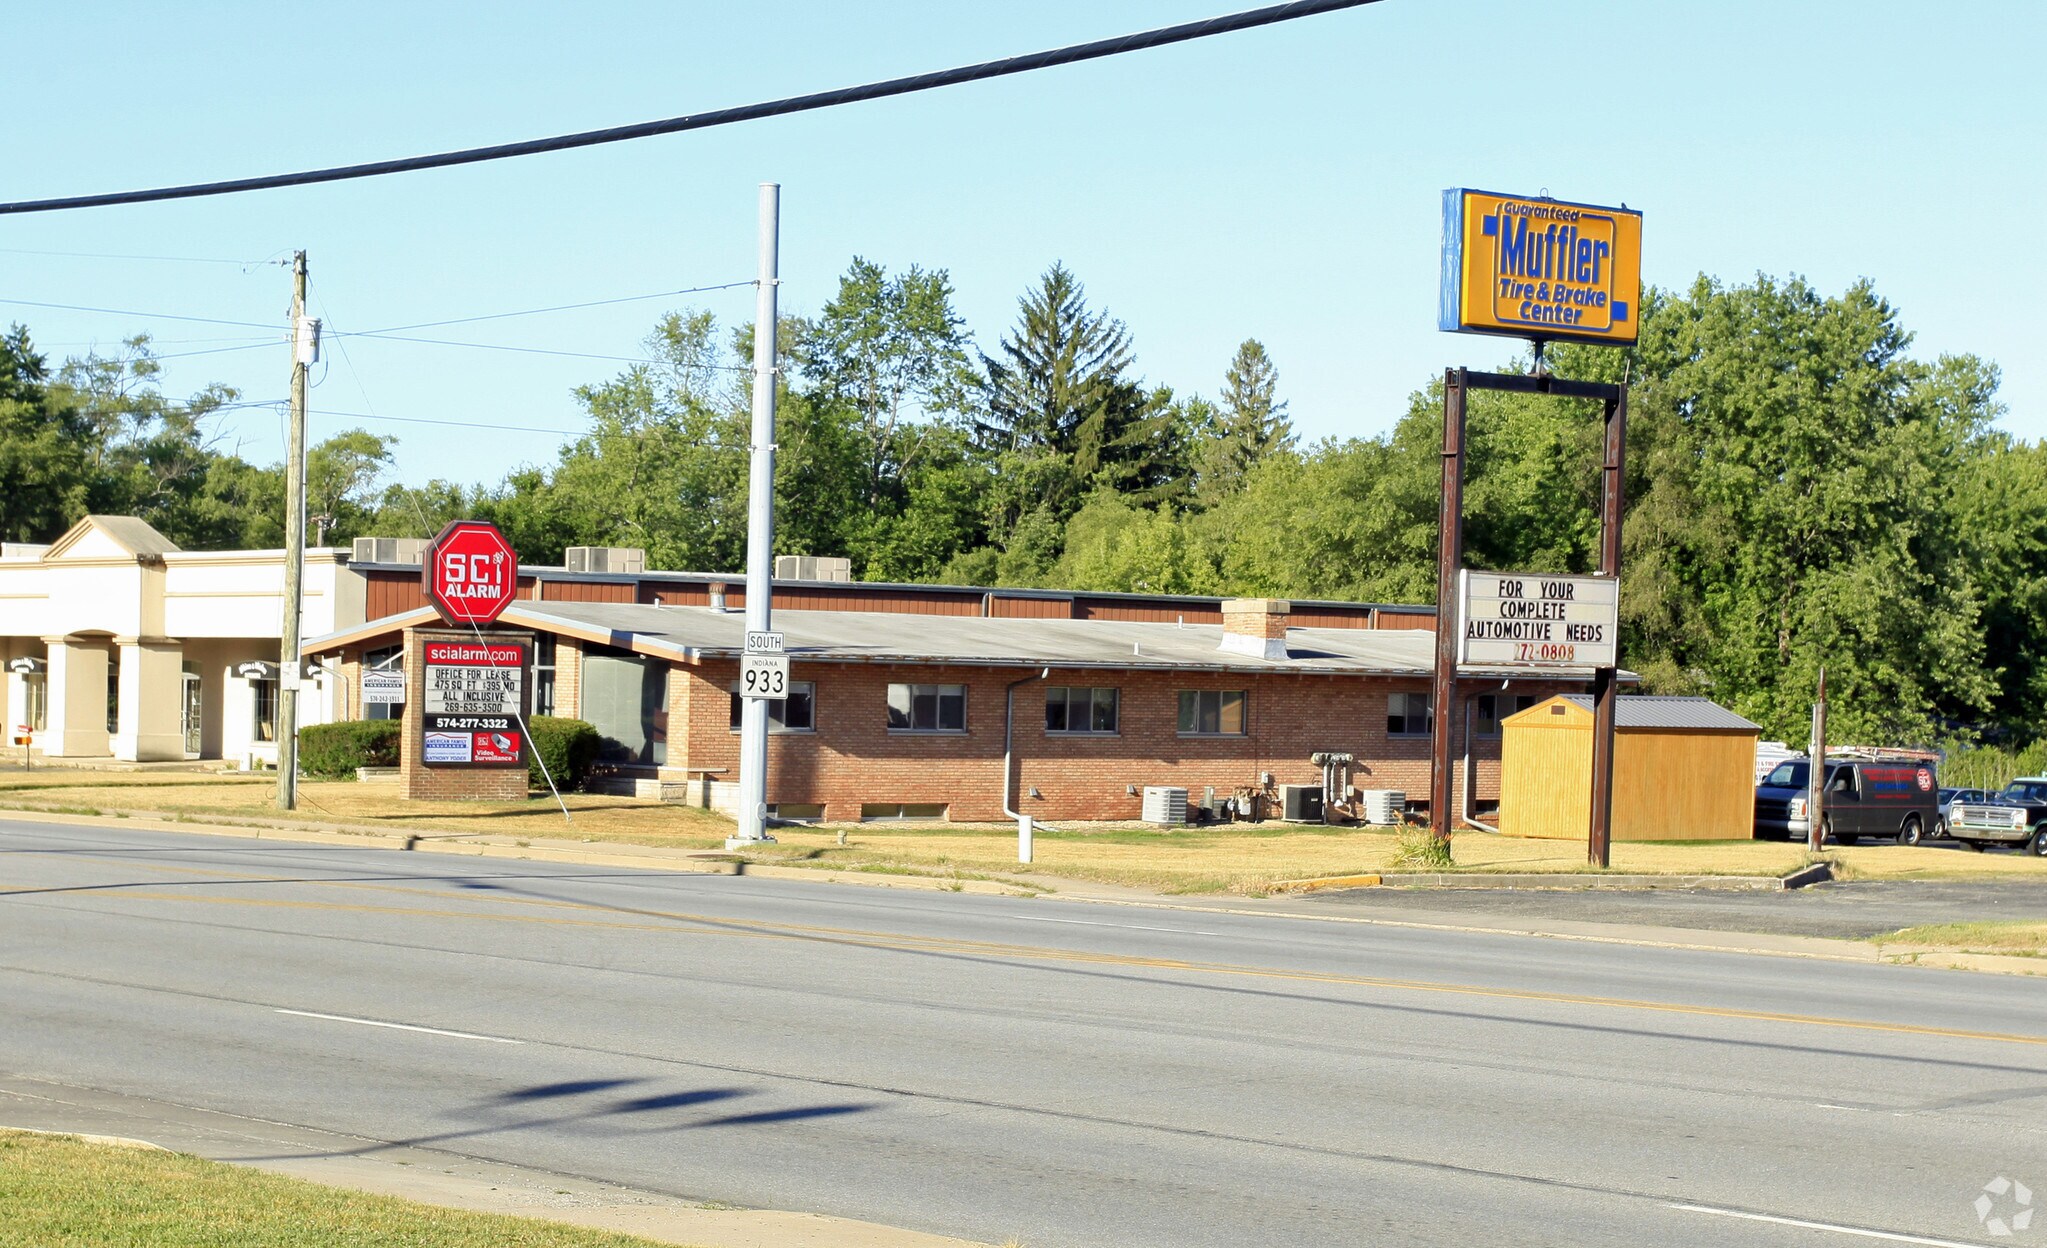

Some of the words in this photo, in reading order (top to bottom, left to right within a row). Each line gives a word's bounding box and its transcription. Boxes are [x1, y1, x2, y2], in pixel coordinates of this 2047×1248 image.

[1503, 200, 1580, 223] Guaranteed
[1499, 213, 1609, 285] Muffler
[1499, 277, 1535, 299] Tire
[1536, 281, 1550, 301] &
[1553, 284, 1607, 308] Brake
[1518, 300, 1583, 324] Center
[445, 583, 501, 599] ALARM
[1499, 580, 1523, 598] FOR
[1540, 581, 1574, 600] YOUR
[1500, 601, 1566, 620] COMPLETE
[1467, 621, 1551, 640] AUTOMOTIVE
[1566, 624, 1603, 642] NEEDS
[750, 635, 782, 649] SOUTH
[430, 646, 518, 662] scialarm.com
[1514, 643, 1575, 661] 272-0808
[751, 659, 778, 667] INDIANA
[435, 669, 462, 680] OFFICE
[467, 670, 481, 680] FOR
[486, 670, 511, 681] LEASE
[745, 669, 783, 693] 933
[434, 680, 450, 690] 475
[451, 681, 462, 691] SQ
[467, 681, 477, 690] FT
[442, 691, 458, 701] ALL
[463, 692, 505, 702] INCLUSIVE
[444, 702, 503, 713] 269-635-3500
[436, 718, 508, 729] 574-277-3322
